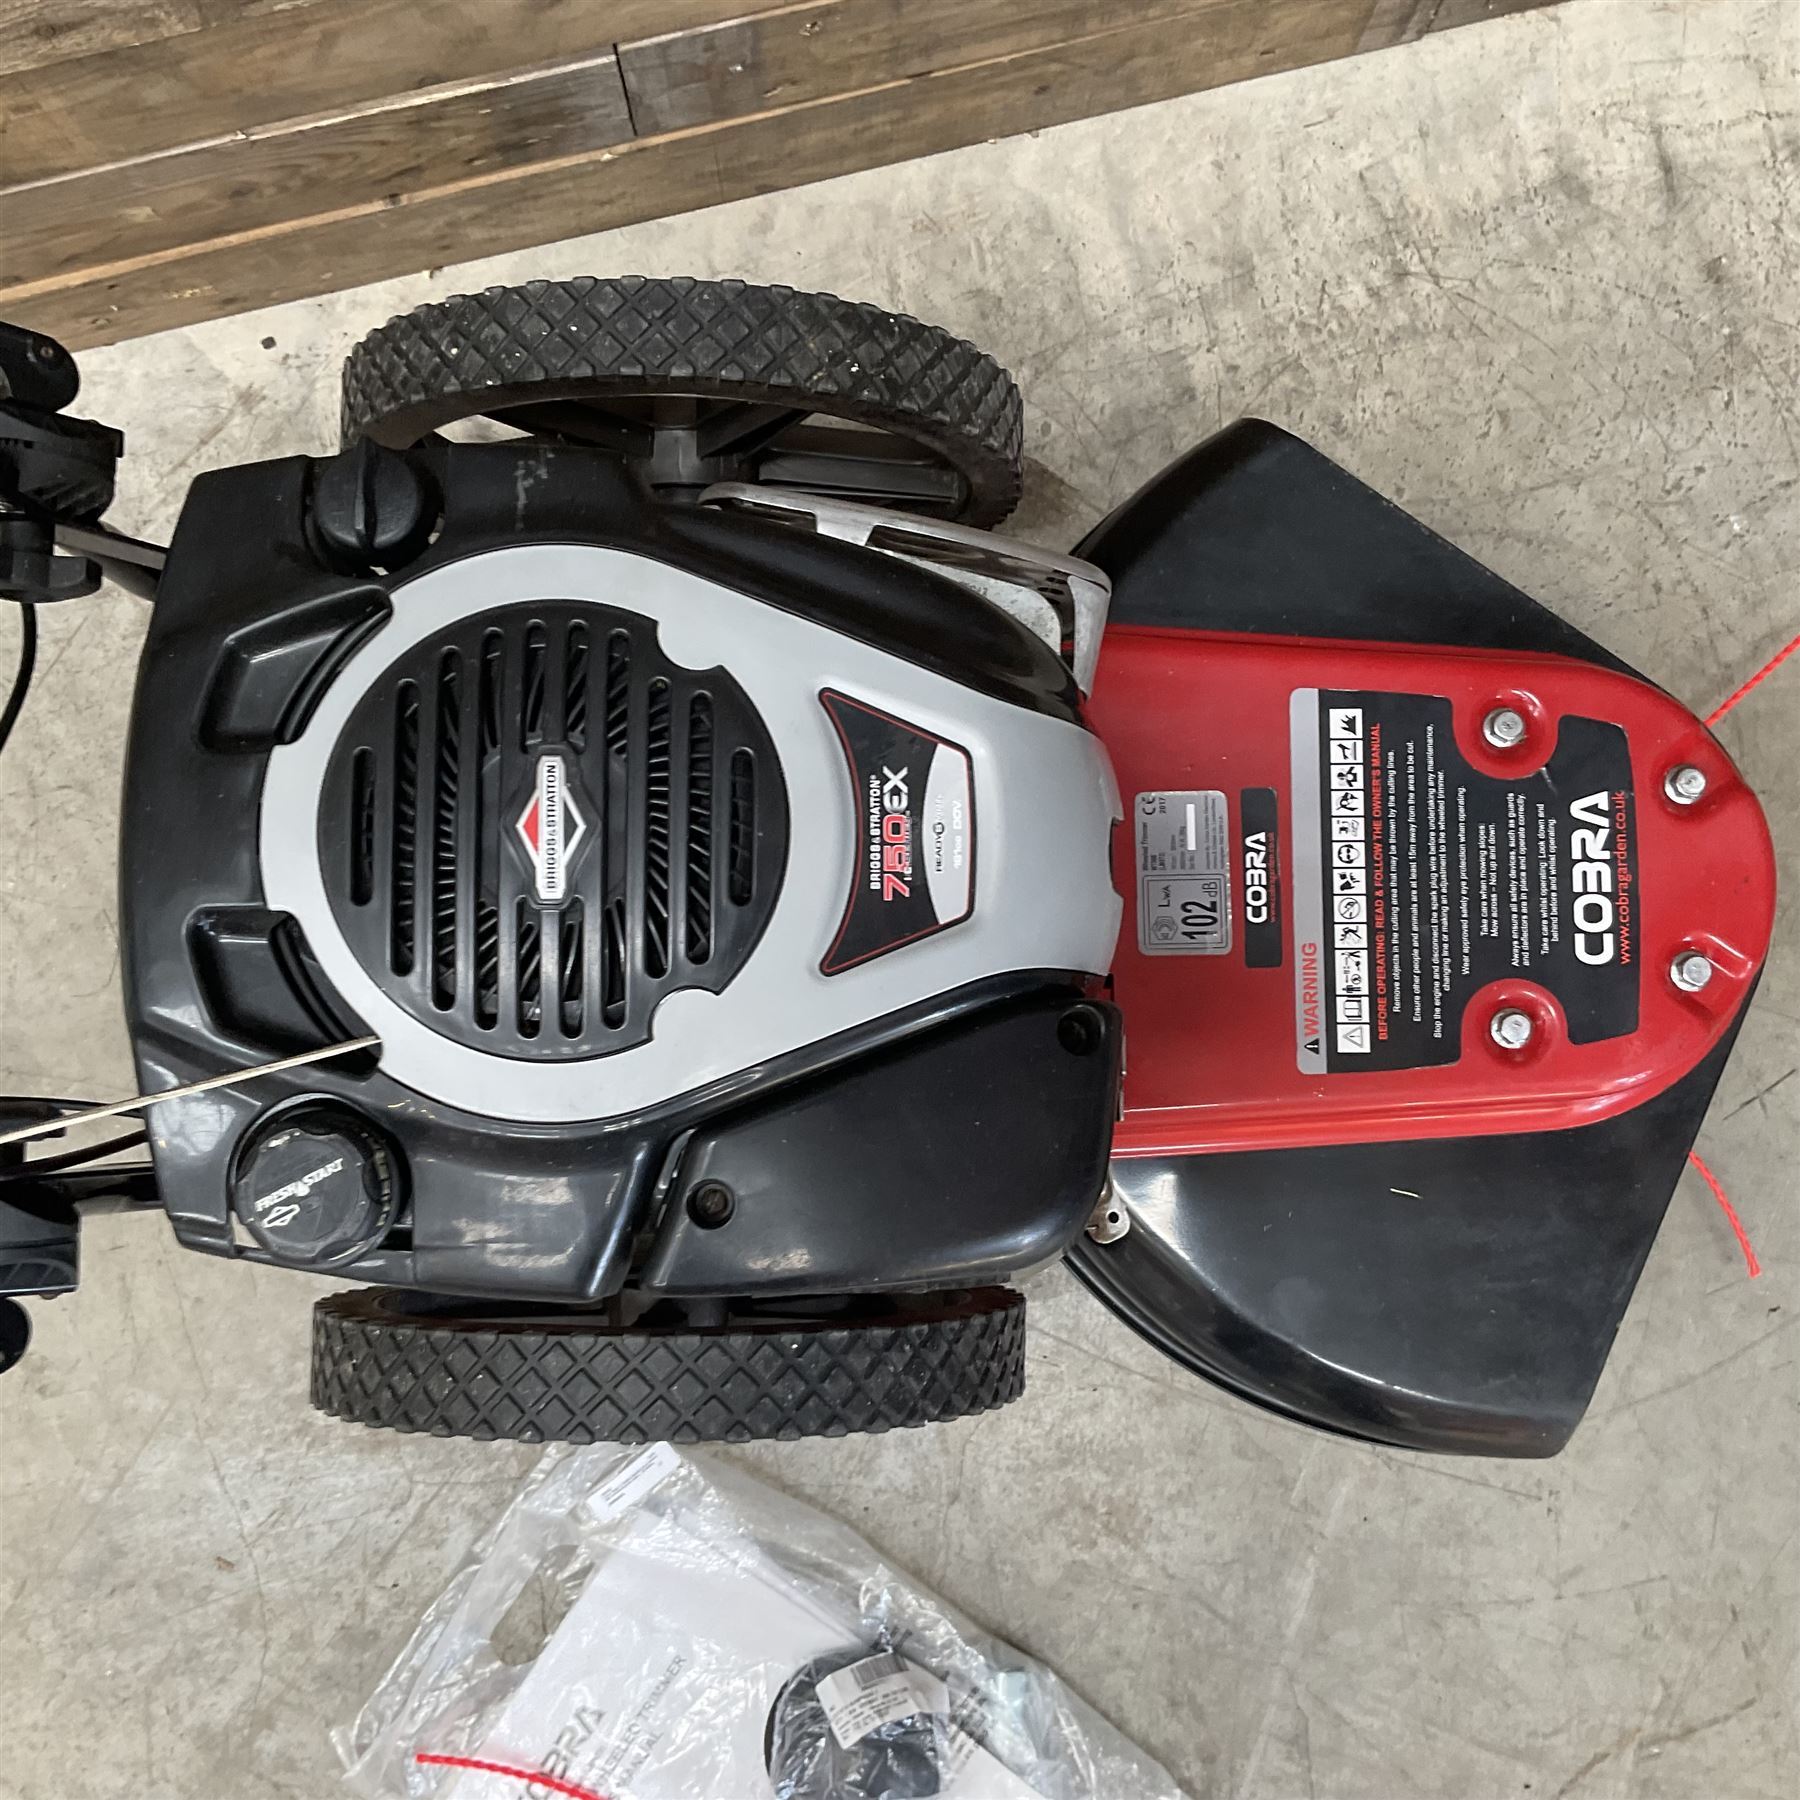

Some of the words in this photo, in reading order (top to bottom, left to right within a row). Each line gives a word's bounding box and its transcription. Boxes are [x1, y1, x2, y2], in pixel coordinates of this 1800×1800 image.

[1370, 724, 1381, 767] MANUAL
[1406, 755, 1414, 765] be
[1406, 765, 1415, 773] to
[1386, 770, 1397, 794] cutting
[1407, 774, 1415, 791] area
[1427, 773, 1436, 786] any
[1371, 769, 1381, 817] OWNER'S
[1387, 795, 1395, 807] the
[1406, 792, 1415, 804] the
[1159, 797, 1167, 814] 2017
[1387, 808, 1397, 818] by
[1407, 805, 1416, 822] from
[1426, 788, 1437, 830] undertaking
[1436, 800, 1445, 830] wheeled
[1506, 793, 1516, 818] guards
[1535, 804, 1545, 817] and
[1372, 821, 1381, 839] THE
[1388, 819, 1396, 843] thrown
[1408, 823, 1418, 843] away
[1457, 822, 1466, 842] when
[1508, 819, 1515, 828] as
[1536, 819, 1546, 839] down
[1427, 831, 1436, 855] before
[1437, 832, 1446, 844] the
[1506, 829, 1516, 847] such
[1516, 827, 1527, 855] operate
[1388, 845, 1397, 854] be
[1408, 844, 1417, 859] 15m
[1487, 846, 1496, 860] and
[1537, 841, 1546, 858] Look
[1373, 843, 1383, 886] FOLLOW
[1390, 855, 1398, 872] may
[1408, 862, 1417, 879] least
[1429, 856, 1437, 871] wire
[1457, 843, 1468, 879] protection
[1479, 850, 1488, 878] mowing
[1489, 861, 1498, 870] up
[1517, 856, 1526, 870] and
[1547, 854, 1557, 875] whilst
[1244, 832, 1267, 923] COBRA
[1389, 873, 1397, 887] that
[1428, 872, 1439, 889] plug
[1438, 854, 1449, 893] adjustment
[1488, 872, 1497, 885] Not
[1518, 871, 1529, 892] place
[1548, 876, 1557, 890] and
[1569, 791, 1614, 965] COBRA
[1612, 791, 1633, 964] www.cobragarden.co.uk
[1390, 888, 1398, 905] area
[1410, 889, 1418, 902] are
[1460, 881, 1469, 895] eye
[1478, 880, 1488, 900] when
[1508, 879, 1519, 902] safety
[1519, 892, 1527, 900] in
[1429, 890, 1439, 910] spark
[1440, 895, 1448, 904] an
[1458, 895, 1470, 918] safety
[1480, 901, 1488, 917] care
[1490, 893, 1498, 917] across
[1509, 903, 1518, 912] all
[1520, 901, 1528, 914] are
[1539, 897, 1548, 918] whilst
[1548, 892, 1558, 915] before
[1181, 901, 1218, 940] 102
[1202, 881, 1218, 898] dB
[1374, 899, 1384, 928] READ
[1390, 906, 1400, 931] cutting
[1409, 903, 1419, 932] animals
[1430, 912, 1438, 923] the
[1439, 905, 1450, 932] making
[1479, 918, 1488, 936] Take
[1489, 919, 1499, 936] Mow
[1510, 913, 1519, 939] ensure
[1519, 915, 1529, 950] deflectors
[1541, 919, 1549, 936] care
[1549, 917, 1559, 941] behind
[1390, 932, 1399, 944] the
[1410, 933, 1419, 947] and
[1430, 925, 1439, 964] disconnect
[1441, 934, 1449, 942] or
[1459, 919, 1470, 953] approved
[1540, 937, 1549, 954] Take
[1392, 945, 1399, 953] in
[1440, 943, 1449, 956] line
[1510, 940, 1521, 967] Always
[1521, 951, 1530, 966] and
[1391, 954, 1401, 980] objects
[1410, 948, 1421, 974] people
[1460, 955, 1470, 975] Wear
[1431, 965, 1440, 979] and
[1441, 957, 1452, 991] changing
[1302, 943, 1319, 1037] WARNING
[1411, 975, 1420, 994] other
[1433, 981, 1442, 1006] engine
[1391, 981, 1401, 1012] Remove
[1412, 995, 1421, 1022] Ensure
[1432, 1007, 1441, 1019] the
[1377, 997, 1387, 1040] BEFORE
[1432, 1020, 1443, 1038] Stop
[517, 1704, 607, 1800] OBRA
